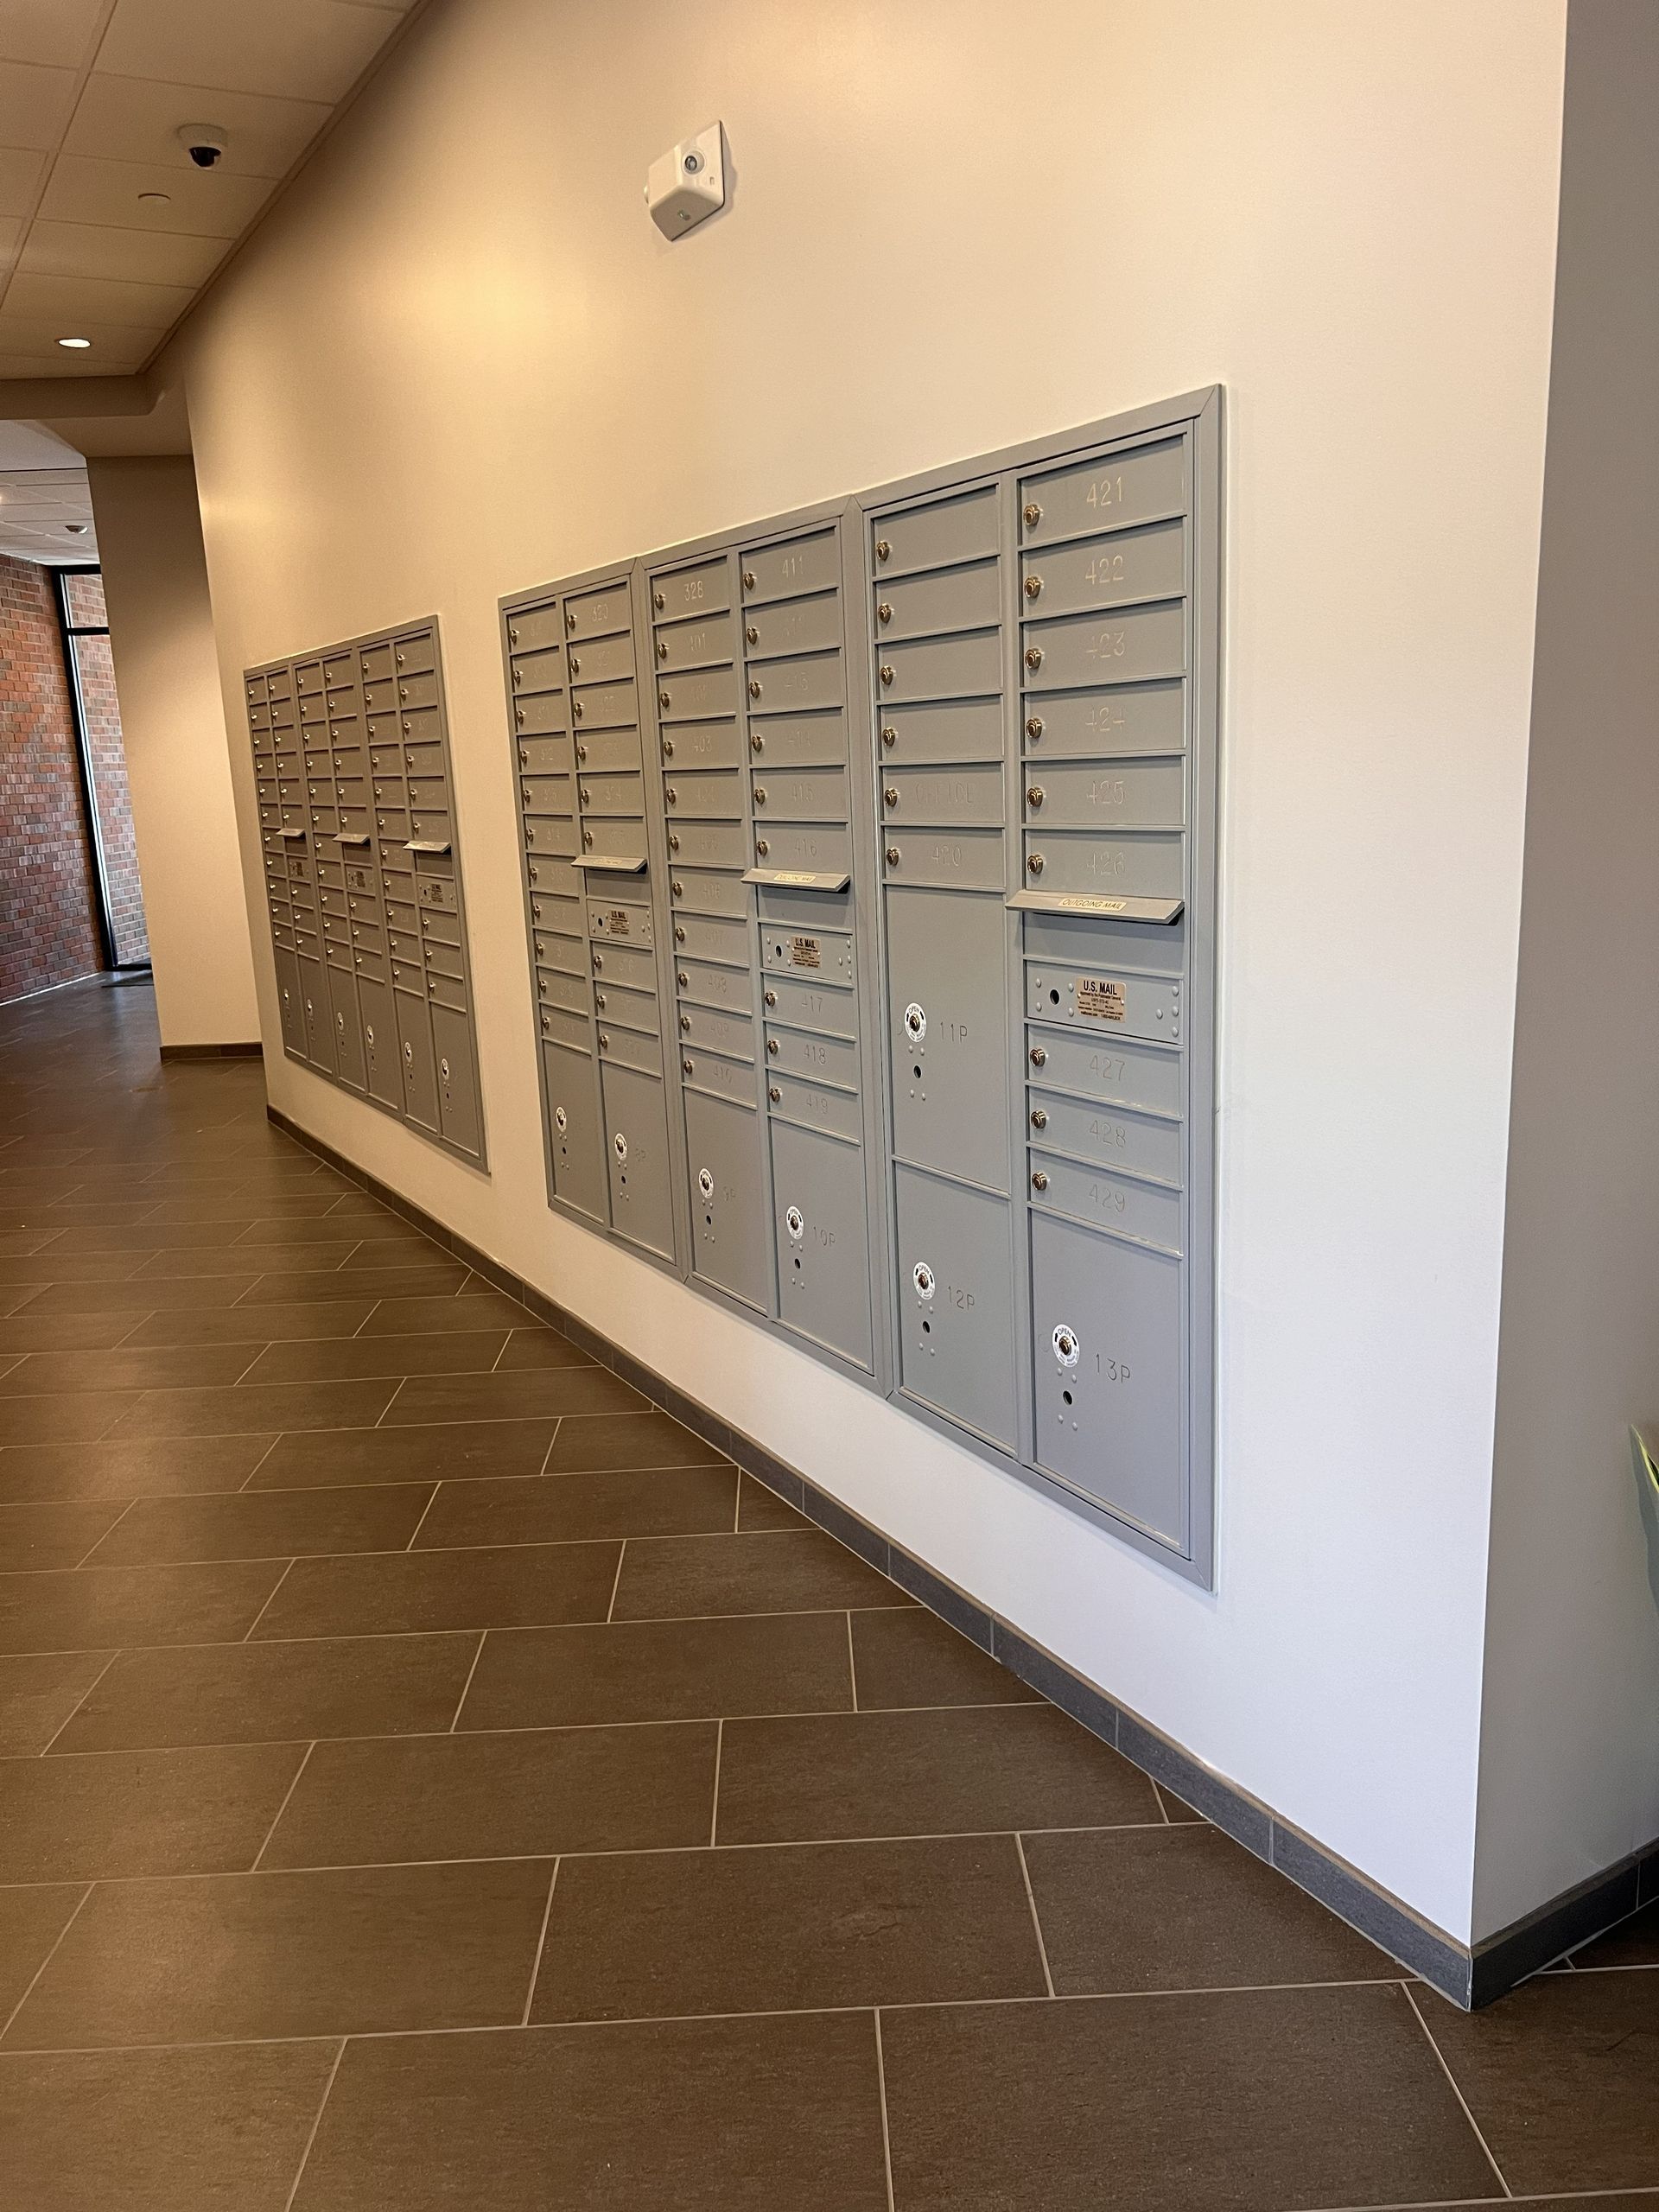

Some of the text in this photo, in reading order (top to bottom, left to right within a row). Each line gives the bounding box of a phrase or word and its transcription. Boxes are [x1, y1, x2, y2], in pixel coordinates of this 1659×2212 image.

[1086, 475, 1122, 508] 421
[781, 556, 804, 578] 411
[1085, 554, 1124, 585] 422
[683, 580, 704, 601] 328
[1086, 631, 1125, 659] 423
[1085, 706, 1125, 732] 424
[1086, 780, 1125, 805] 425
[794, 837, 818, 857] 416
[931, 844, 962, 868] 420
[1086, 850, 1126, 875] 426
[1062, 899, 1103, 908] OUTGOING
[1084, 980, 1117, 995] U.S. MAIL
[801, 994, 823, 1013] 417
[940, 1021, 968, 1044] 11P
[804, 1044, 827, 1065] 418
[1089, 1054, 1125, 1081] 427
[805, 1094, 830, 1116] 419
[1089, 1120, 1126, 1147] 428
[1088, 1184, 1125, 1212] 429
[812, 1225, 836, 1246] 10P
[948, 1286, 975, 1311] 12P
[1096, 1353, 1131, 1383] 13P
